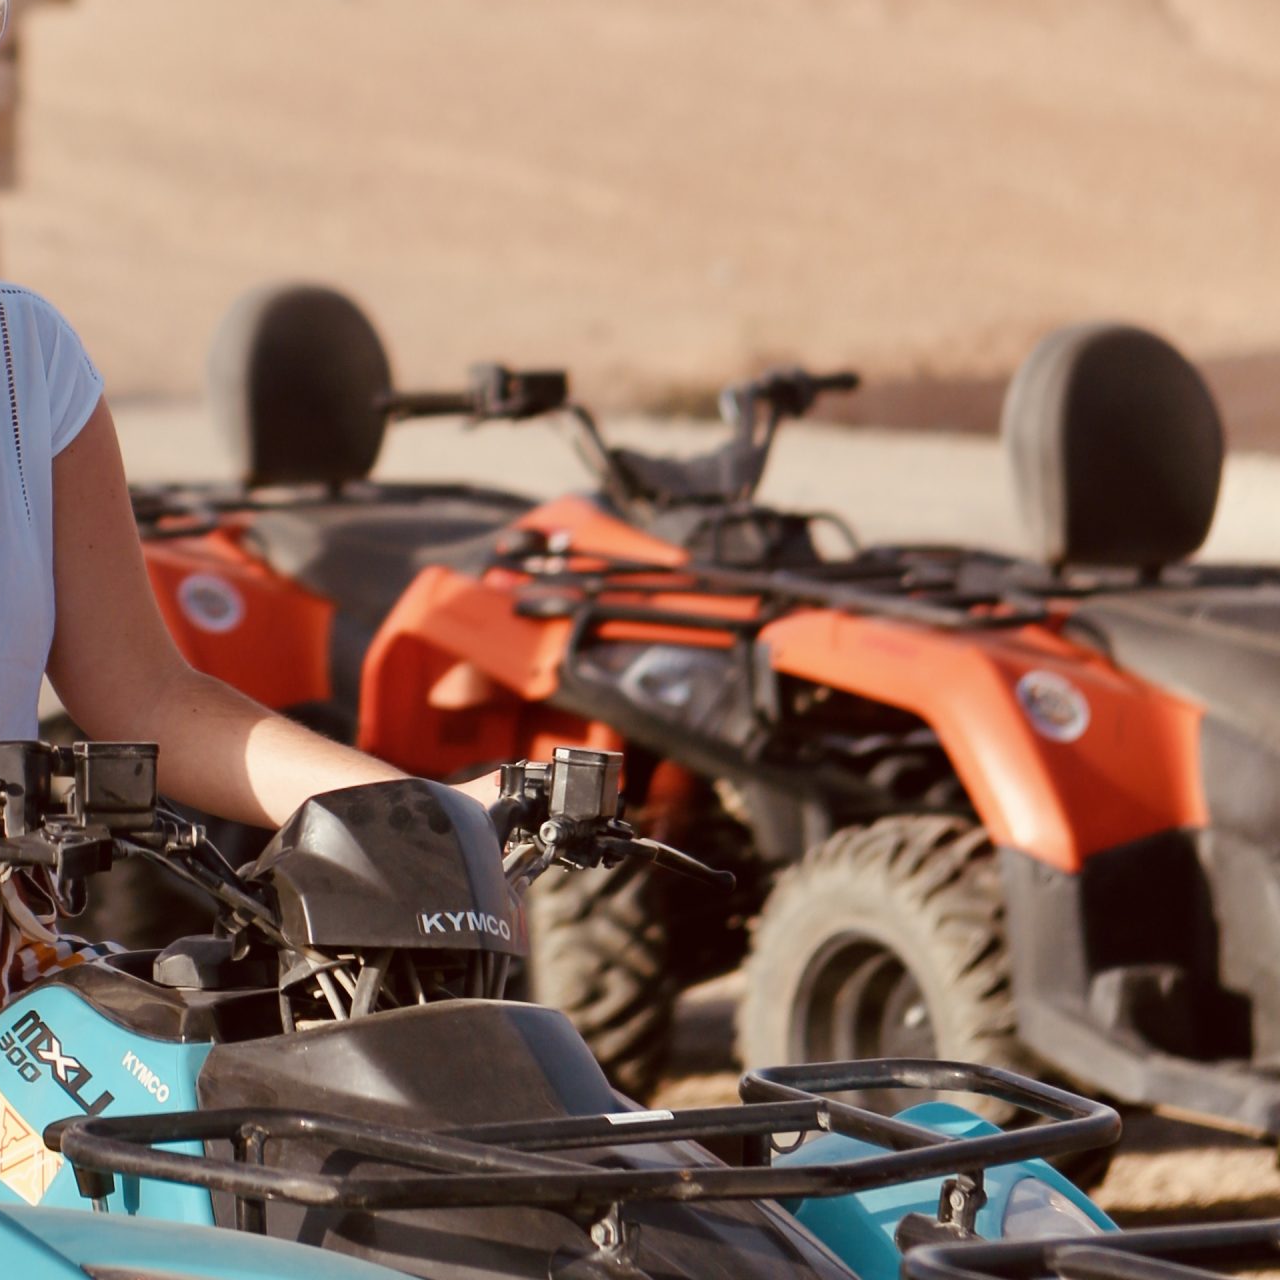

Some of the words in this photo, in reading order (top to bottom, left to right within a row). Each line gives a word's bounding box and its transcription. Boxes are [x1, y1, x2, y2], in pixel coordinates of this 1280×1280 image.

[421, 911, 510, 941] KYMCO
[11, 1010, 115, 1116] MXU
[122, 1050, 170, 1103] KYMCO
